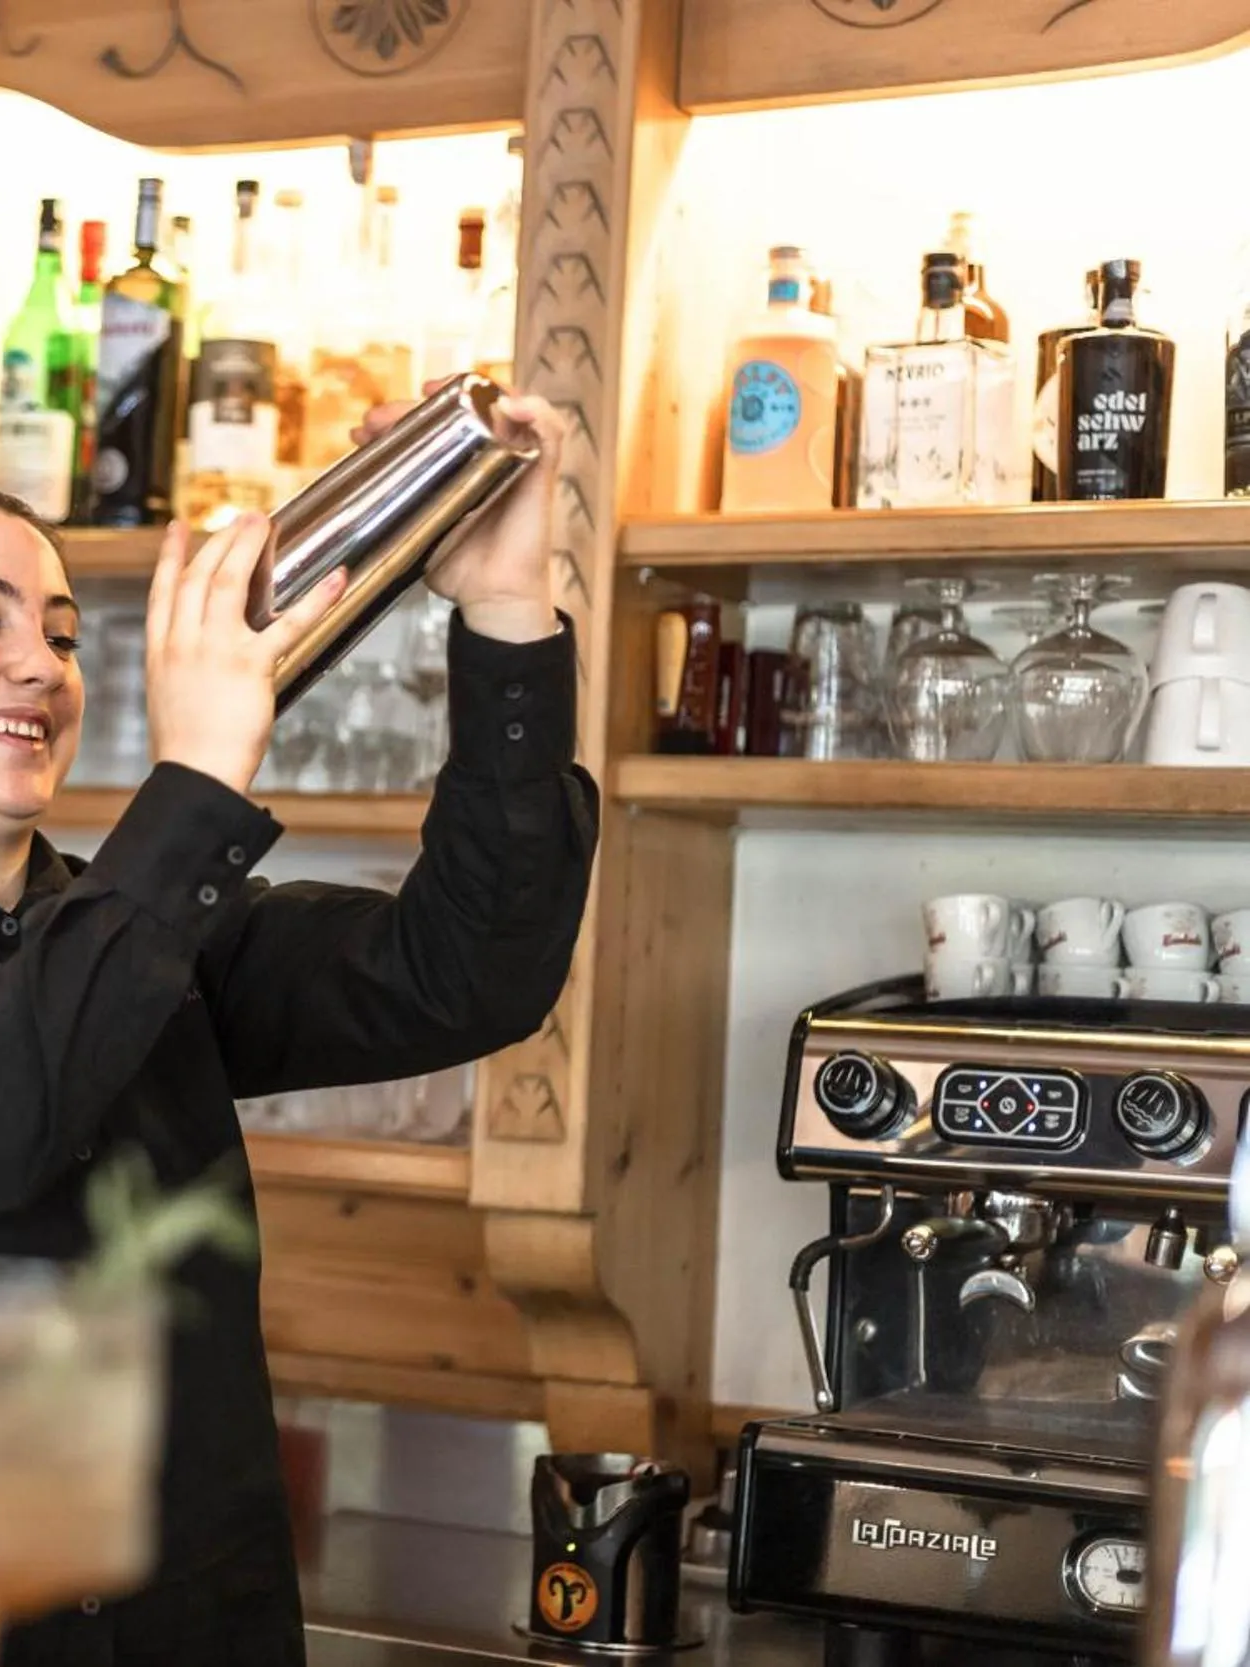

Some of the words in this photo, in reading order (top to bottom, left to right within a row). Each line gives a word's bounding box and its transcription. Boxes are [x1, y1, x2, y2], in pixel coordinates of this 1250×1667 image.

[1093, 390, 1147, 412] edel
[1077, 411, 1147, 432] schw
[1077, 432, 1119, 451] arz
